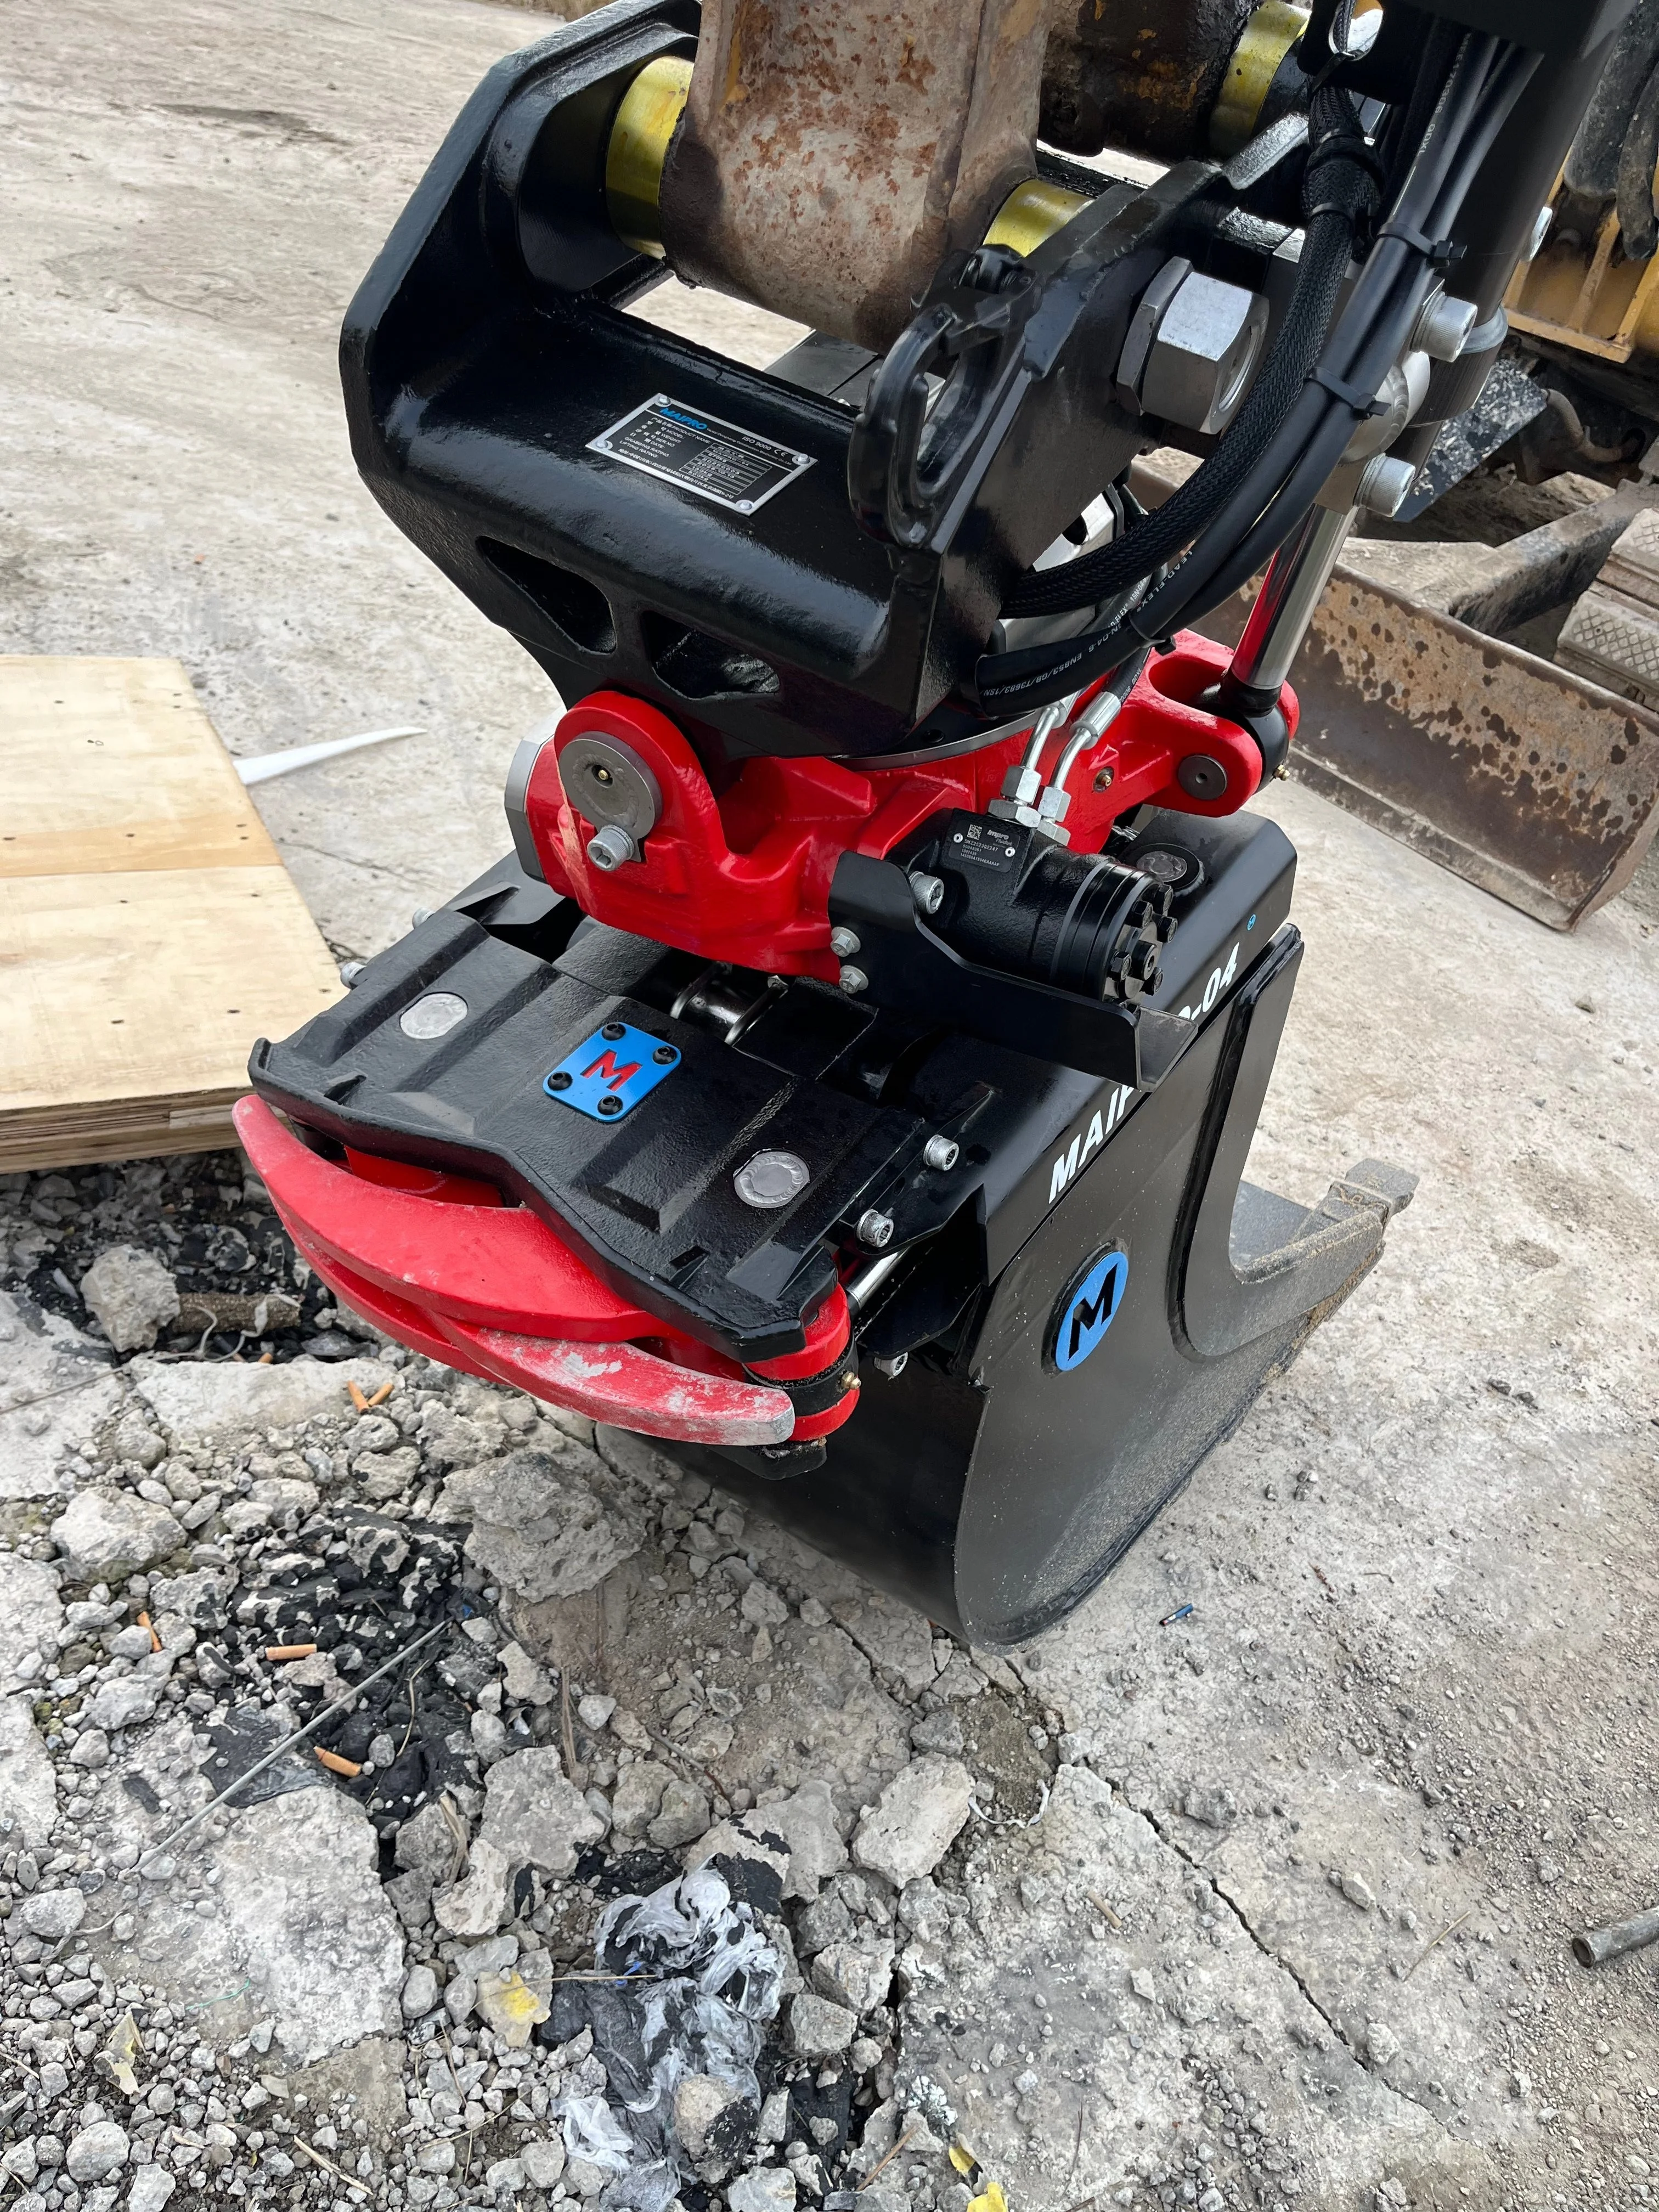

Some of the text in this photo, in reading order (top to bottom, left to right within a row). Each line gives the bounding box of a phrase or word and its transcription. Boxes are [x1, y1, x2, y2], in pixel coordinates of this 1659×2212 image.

[659, 408, 707, 429] MAIPRO
[755, 442, 772, 450] 9000
[580, 1048, 642, 1092] M
[1068, 1262, 1118, 1359] M
